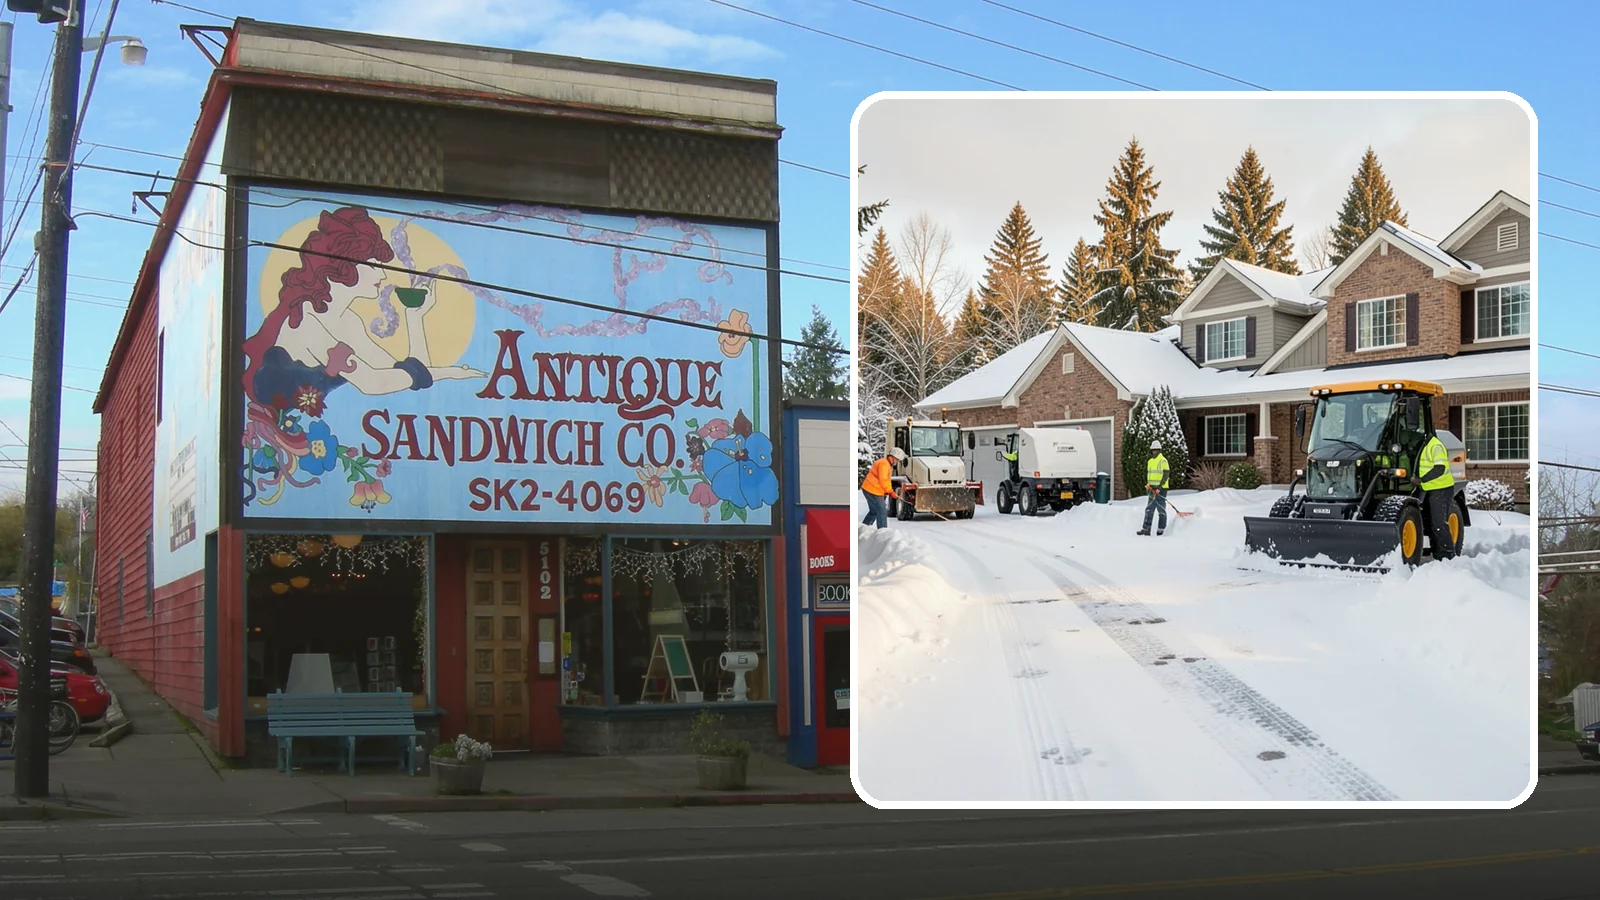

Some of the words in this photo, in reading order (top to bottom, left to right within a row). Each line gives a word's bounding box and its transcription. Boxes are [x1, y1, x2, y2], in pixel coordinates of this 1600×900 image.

[475, 329, 723, 420] ANTIQUE
[361, 408, 605, 468] SANDWICH
[617, 421, 685, 470] CO.
[468, 477, 646, 514] SK2-4069
[539, 541, 552, 600] 5102
[809, 555, 835, 569] BOOKS
